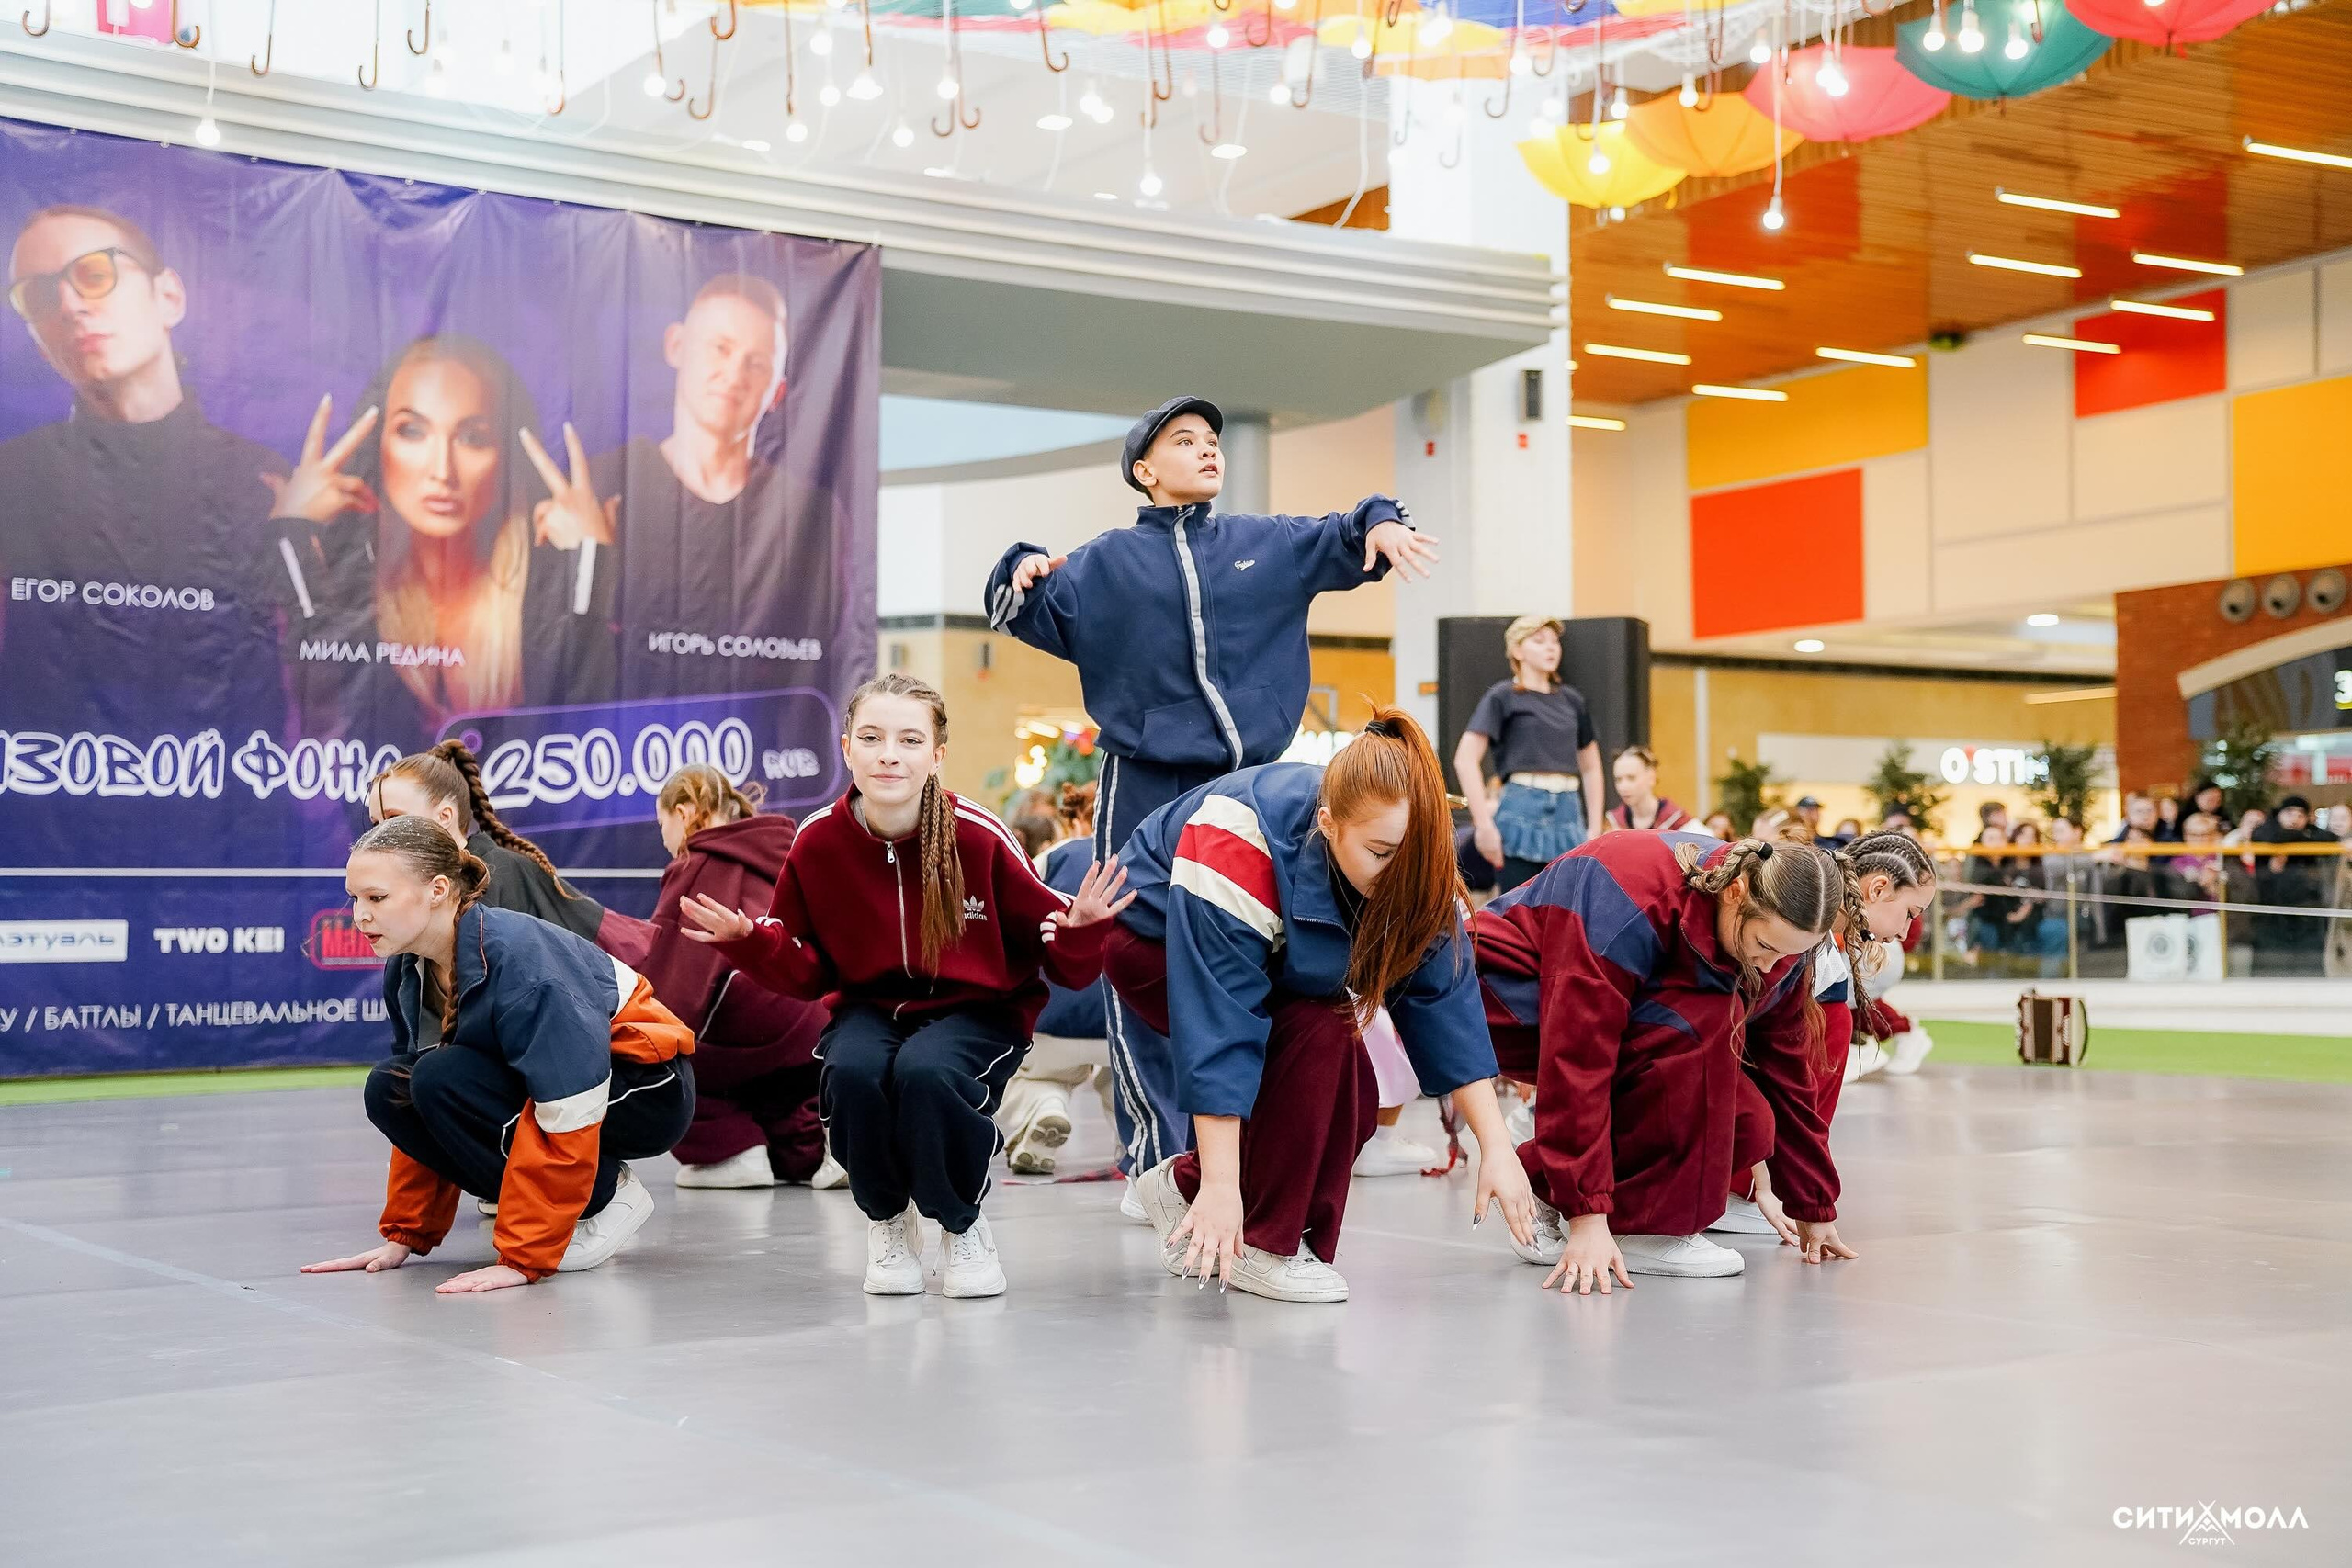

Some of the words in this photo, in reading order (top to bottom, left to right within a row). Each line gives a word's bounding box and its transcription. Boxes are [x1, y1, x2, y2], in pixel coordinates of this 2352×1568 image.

[11, 577, 76, 603] ЕГОР
[82, 581, 215, 611] СОКОЛОВ
[299, 639, 371, 663] МИЛА
[375, 642, 466, 667] РЕДИНА
[649, 631, 716, 655] ИГОРЬ
[717, 634, 822, 660] СОЛОВЬЕВ
[0, 728, 225, 798] ЗОВОЙ
[481, 717, 753, 809] 250.000
[153, 927, 228, 953] TWO
[45, 1004, 141, 1030] БАТТЛЫ
[165, 998, 357, 1027] ТАНЦЕВАЛЬНОЕ
[362, 998, 390, 1021] Ш
